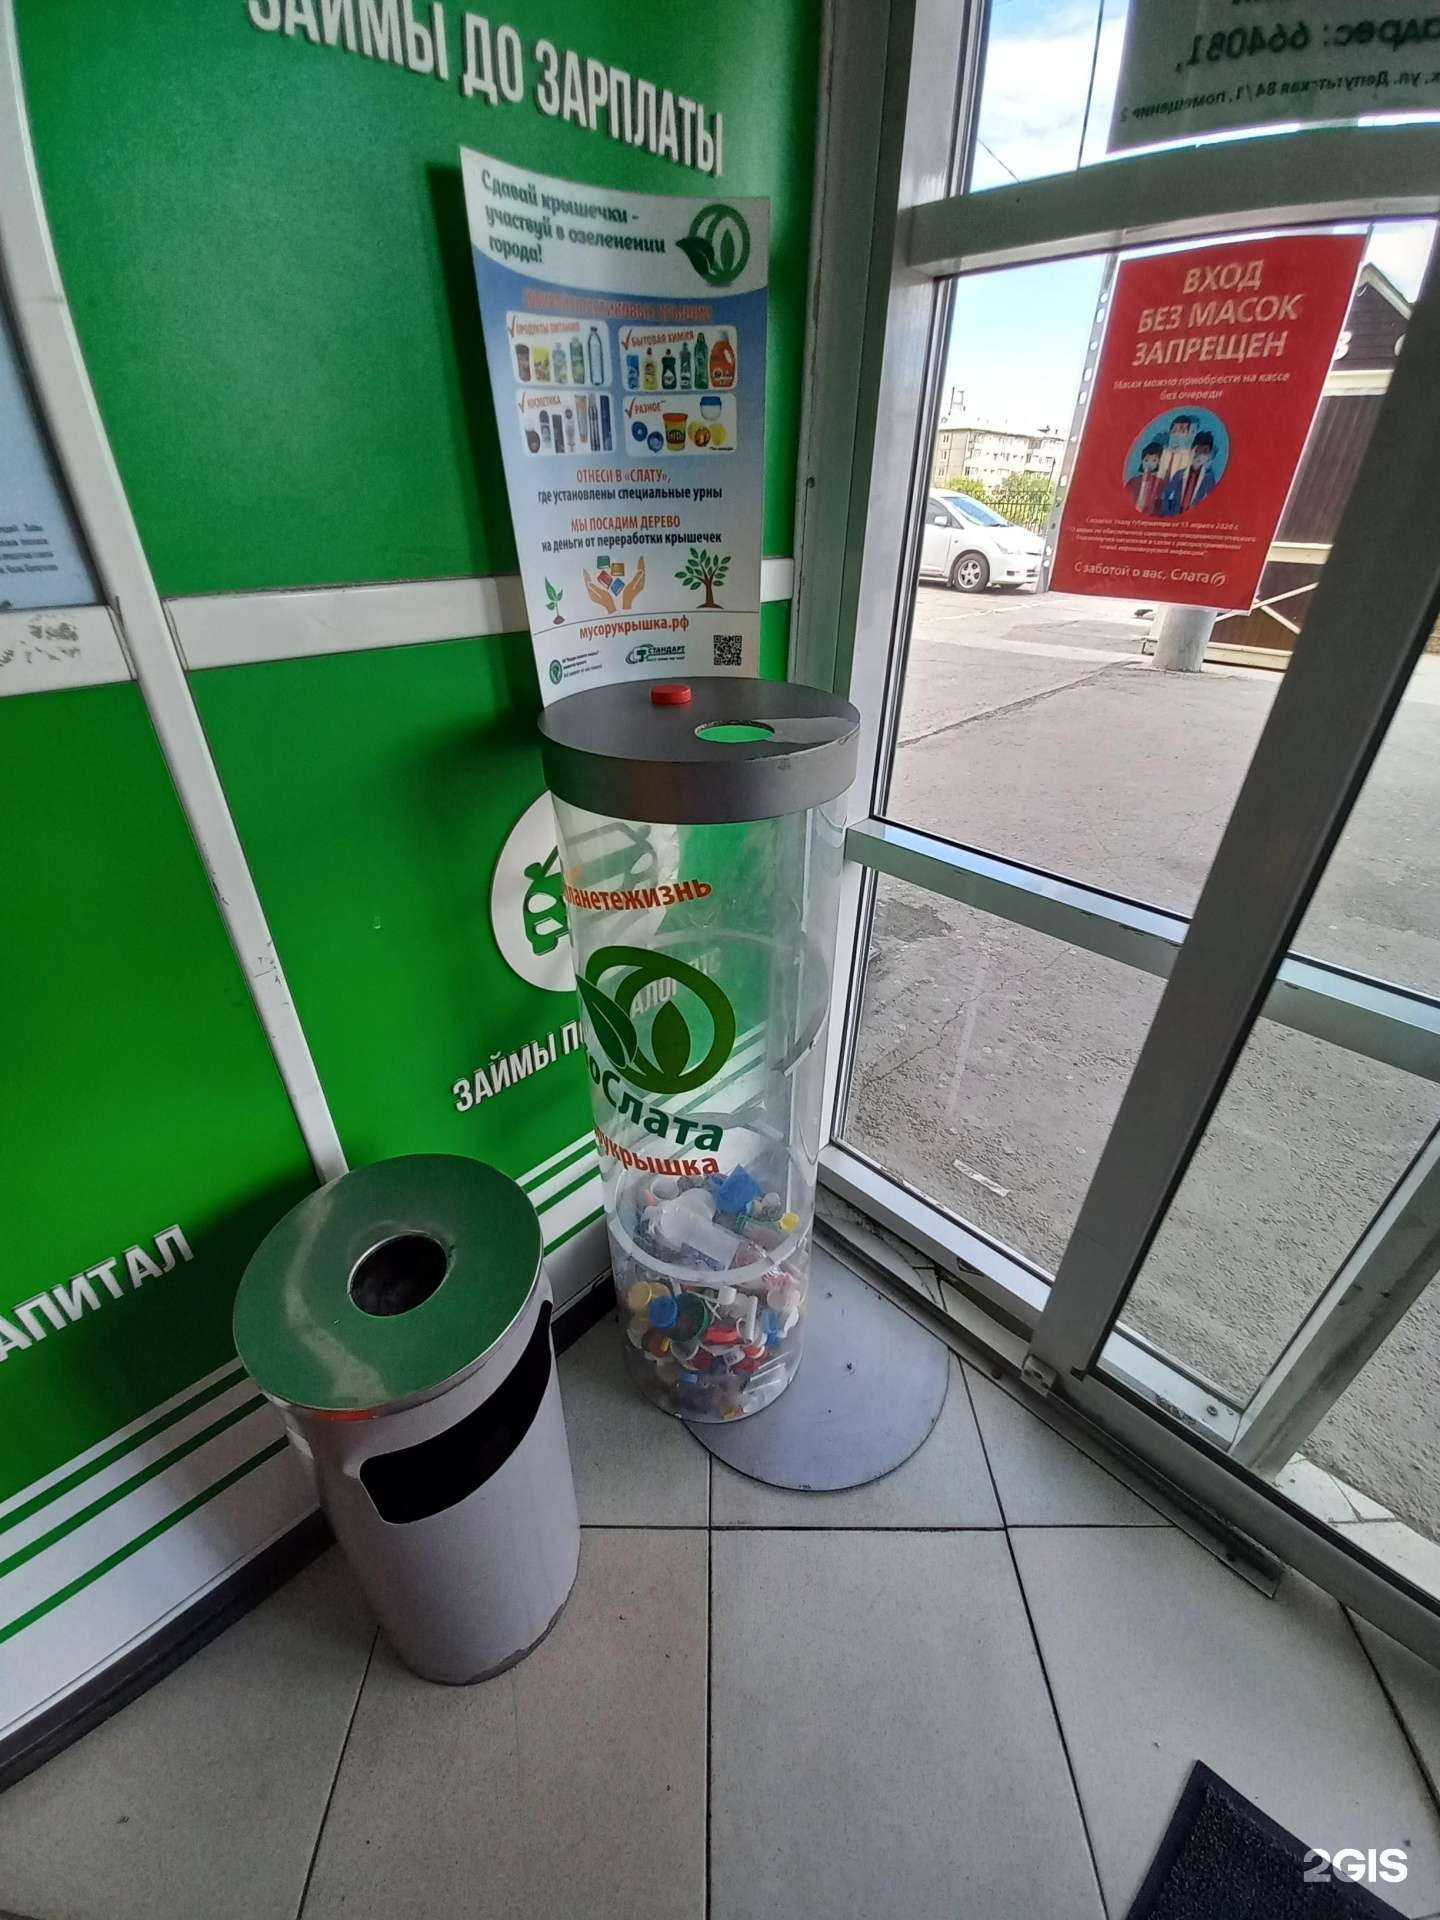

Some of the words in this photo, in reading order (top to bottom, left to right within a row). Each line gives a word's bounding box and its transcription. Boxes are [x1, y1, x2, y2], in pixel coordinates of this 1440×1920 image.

[463, 13, 524, 105] ДО
[536, 40, 723, 176] ЗАРПЛАТЫ
[481, 168, 538, 206] Сдавай
[541, 192, 628, 224] крышечки
[485, 204, 552, 241] участвуй
[556, 225, 566, 241] в
[568, 227, 666, 254] озеленении
[489, 235, 543, 264] города!
[1182, 258, 1265, 295] ВХОД
[1137, 304, 1184, 334] БЕЗ
[1187, 293, 1306, 329] МАСОК
[1131, 330, 1289, 367] ЗАПРЕЩЕН
[1179, 373, 1242, 391] приобрести
[1243, 374, 1256, 384] на
[1259, 371, 1291, 383] кассе
[576, 468, 613, 484] ОТНЕСИ
[616, 469, 622, 483] В
[538, 489, 551, 505] где
[553, 488, 616, 506] установлены
[618, 486, 691, 502] специальные
[693, 487, 723, 502] урны
[571, 517, 587, 533] МЫ
[590, 516, 638, 533] ПОСАДИМ
[640, 514, 681, 530] ДЕРЕВО
[541, 540, 552, 552] на
[553, 536, 584, 554] деньги
[586, 536, 595, 548] от
[597, 530, 663, 549] переработки
[665, 532, 722, 547] крышечек
[1074, 561, 1083, 573] С
[1083, 562, 1131, 577] заботой
[1142, 569, 1166, 584] вас,
[1171, 568, 1210, 584] Слата
[580, 614, 690, 641] мусорукрышка.рф
[452, 1031, 558, 1112] ЗАЙМЫ
[0, 1224, 194, 1362] АПИТАЛ
